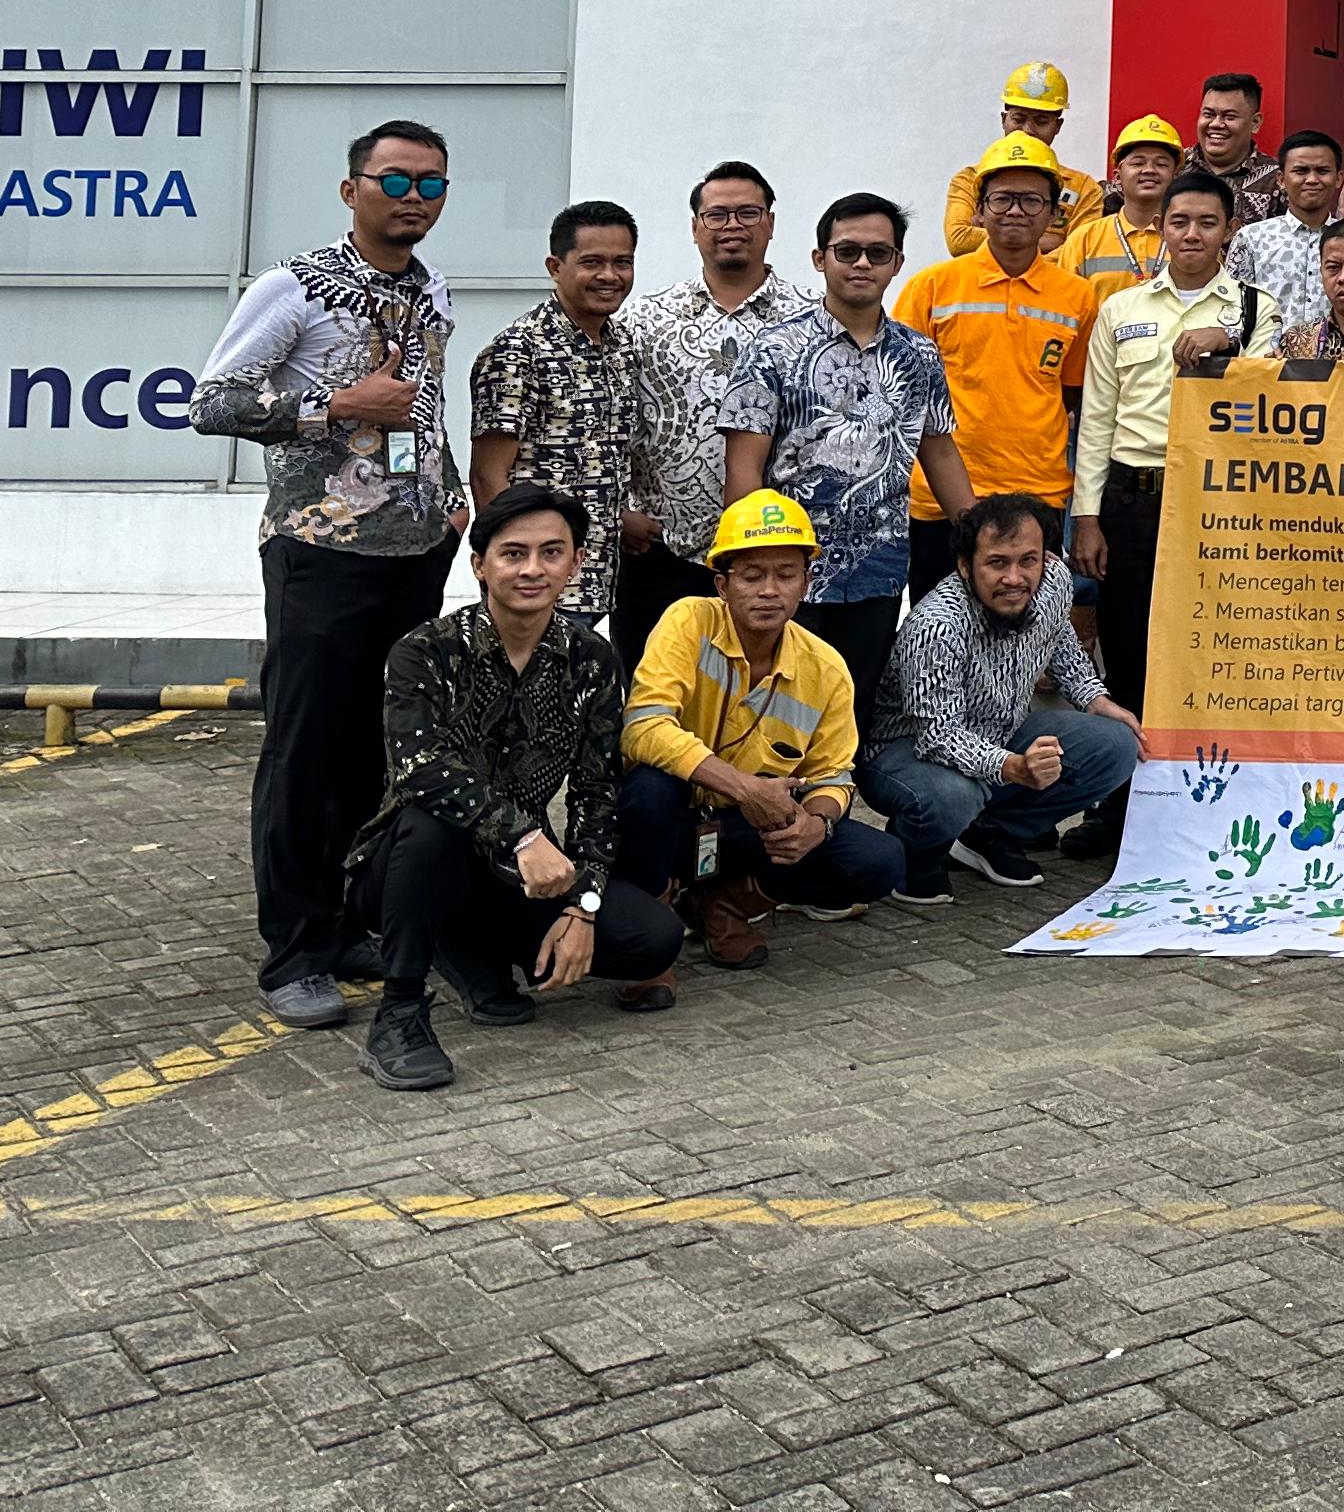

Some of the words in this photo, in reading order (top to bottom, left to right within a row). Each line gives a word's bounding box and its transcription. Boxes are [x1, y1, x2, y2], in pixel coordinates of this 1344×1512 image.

[0, 170, 197, 217] ASTRA
[8, 367, 197, 429] nce
[1201, 513, 1264, 531] Untuk
[1198, 542, 1249, 560] kami
[1197, 572, 1211, 590] 1.
[1218, 572, 1316, 595] Mencegah
[1192, 602, 1208, 619] 2.
[1216, 602, 1330, 622] Memastikan
[1189, 632, 1205, 650] 3.
[1213, 632, 1328, 652] Memastikan
[1211, 662, 1237, 680] PT.
[1244, 663, 1285, 681] Bina
[1183, 692, 1199, 709] 4.
[1206, 692, 1299, 715] Mencapai
